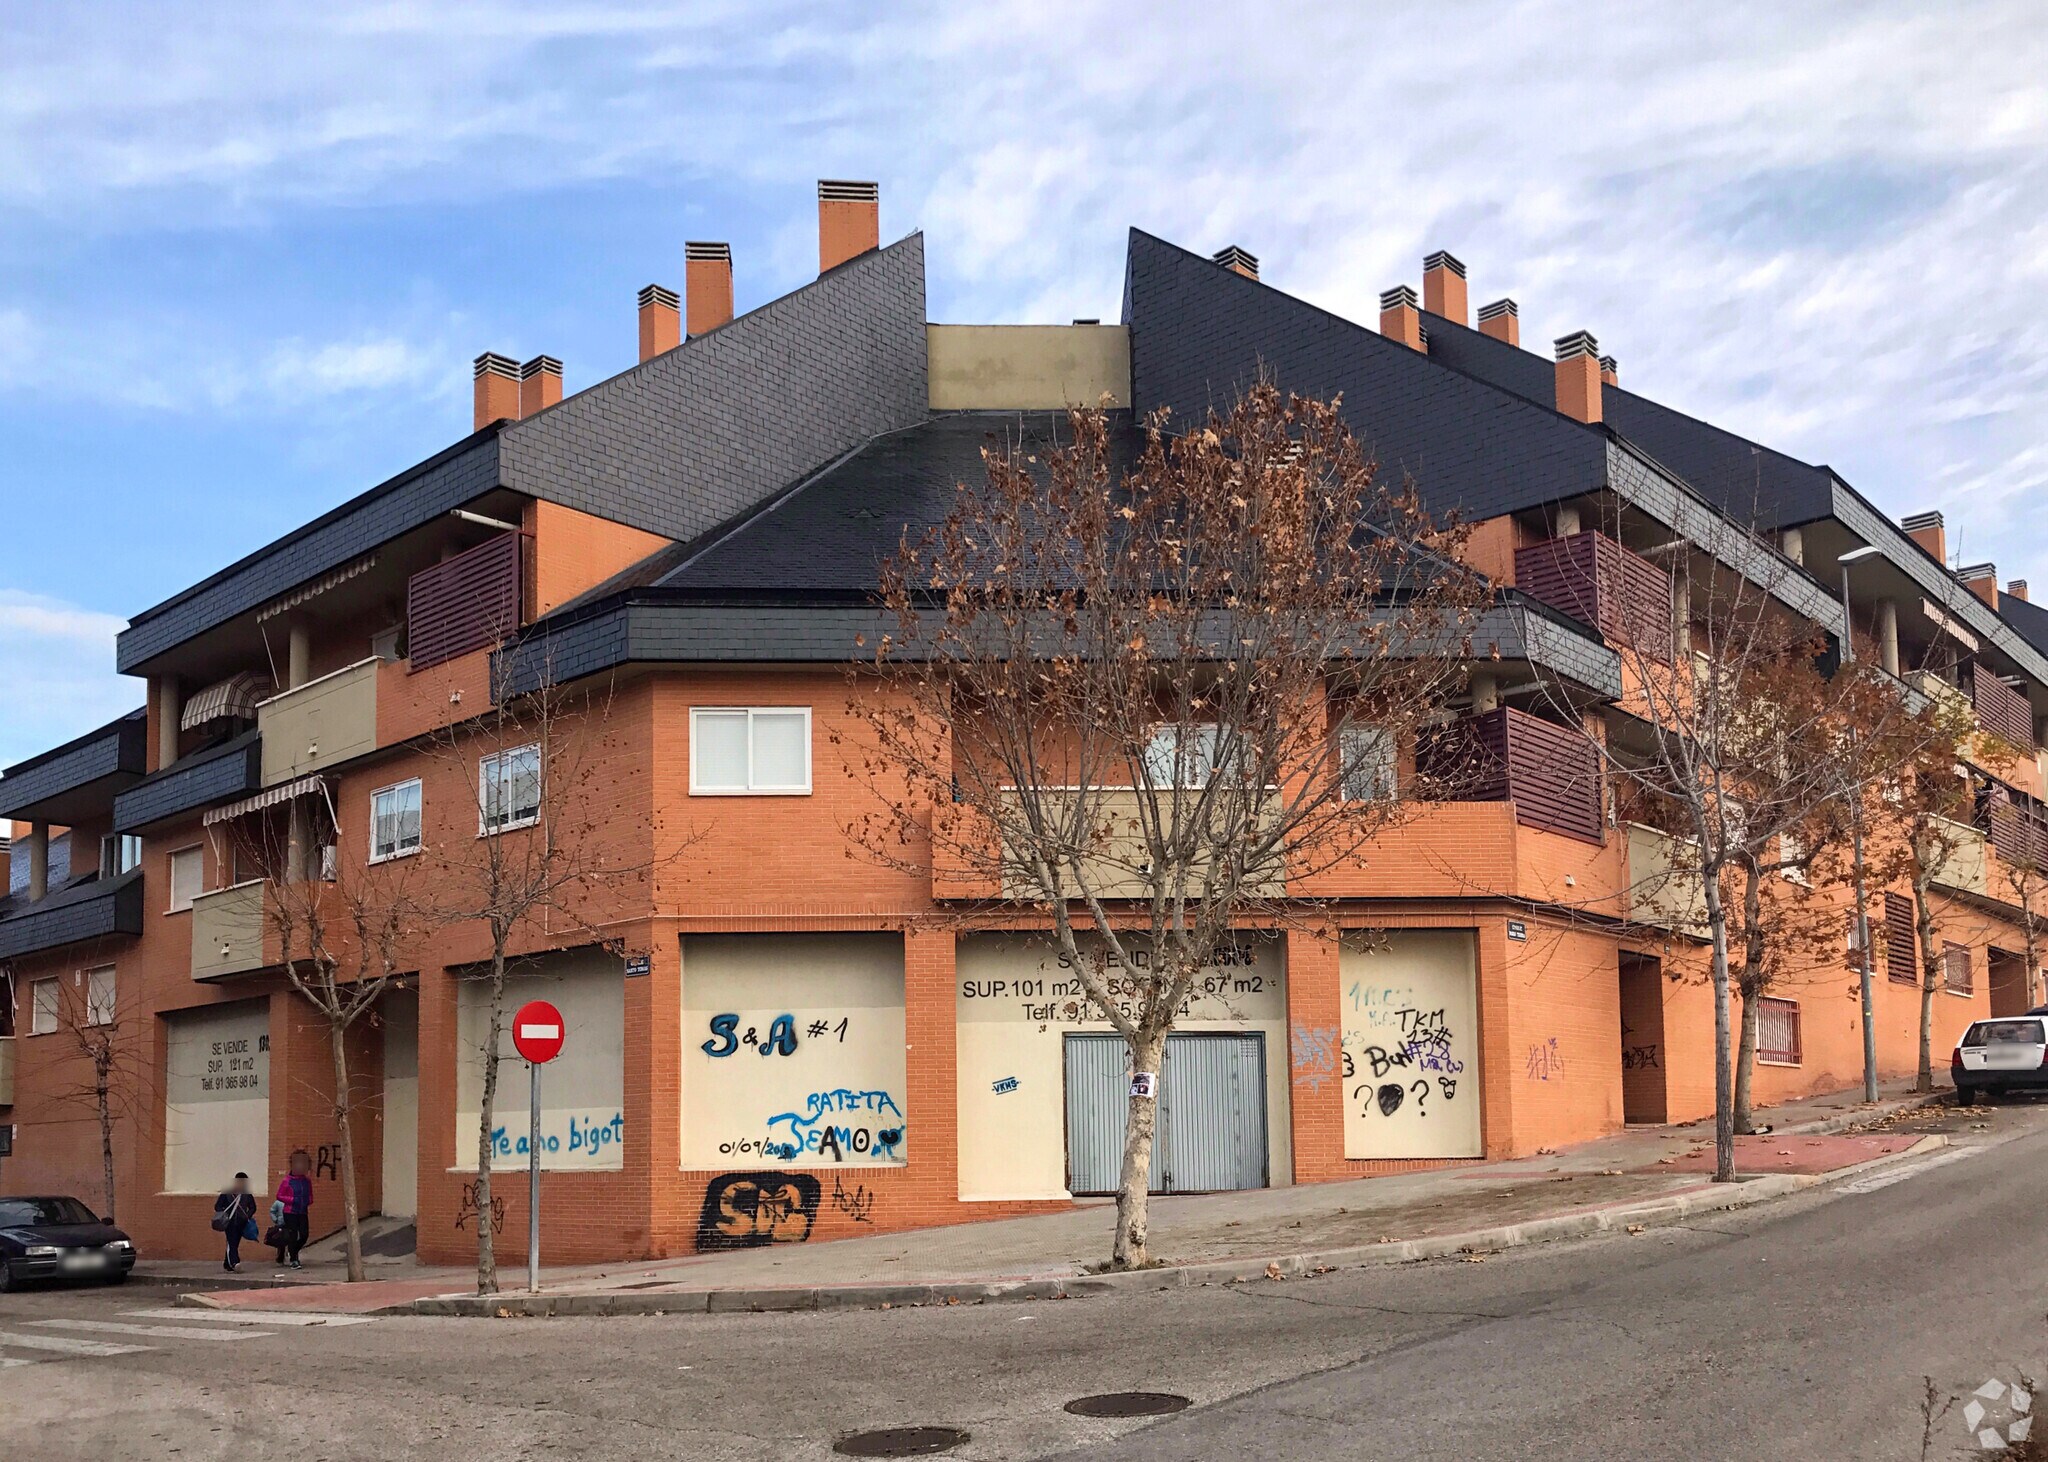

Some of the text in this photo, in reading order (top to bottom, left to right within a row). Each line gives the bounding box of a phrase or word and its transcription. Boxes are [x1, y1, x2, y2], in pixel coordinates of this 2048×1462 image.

[1052, 979, 1081, 996] m2
[1235, 976, 1263, 993] m2
[1395, 1009, 1444, 1032] TKM
[212, 1042, 222, 1055] SE
[223, 1040, 249, 1055] VENDE
[243, 1057, 254, 1070] m2
[215, 1077, 224, 1090] 91
[225, 1076, 238, 1089] 365
[239, 1075, 248, 1088] 98
[249, 1074, 258, 1088] 04
[807, 1089, 902, 1118] RATITA
